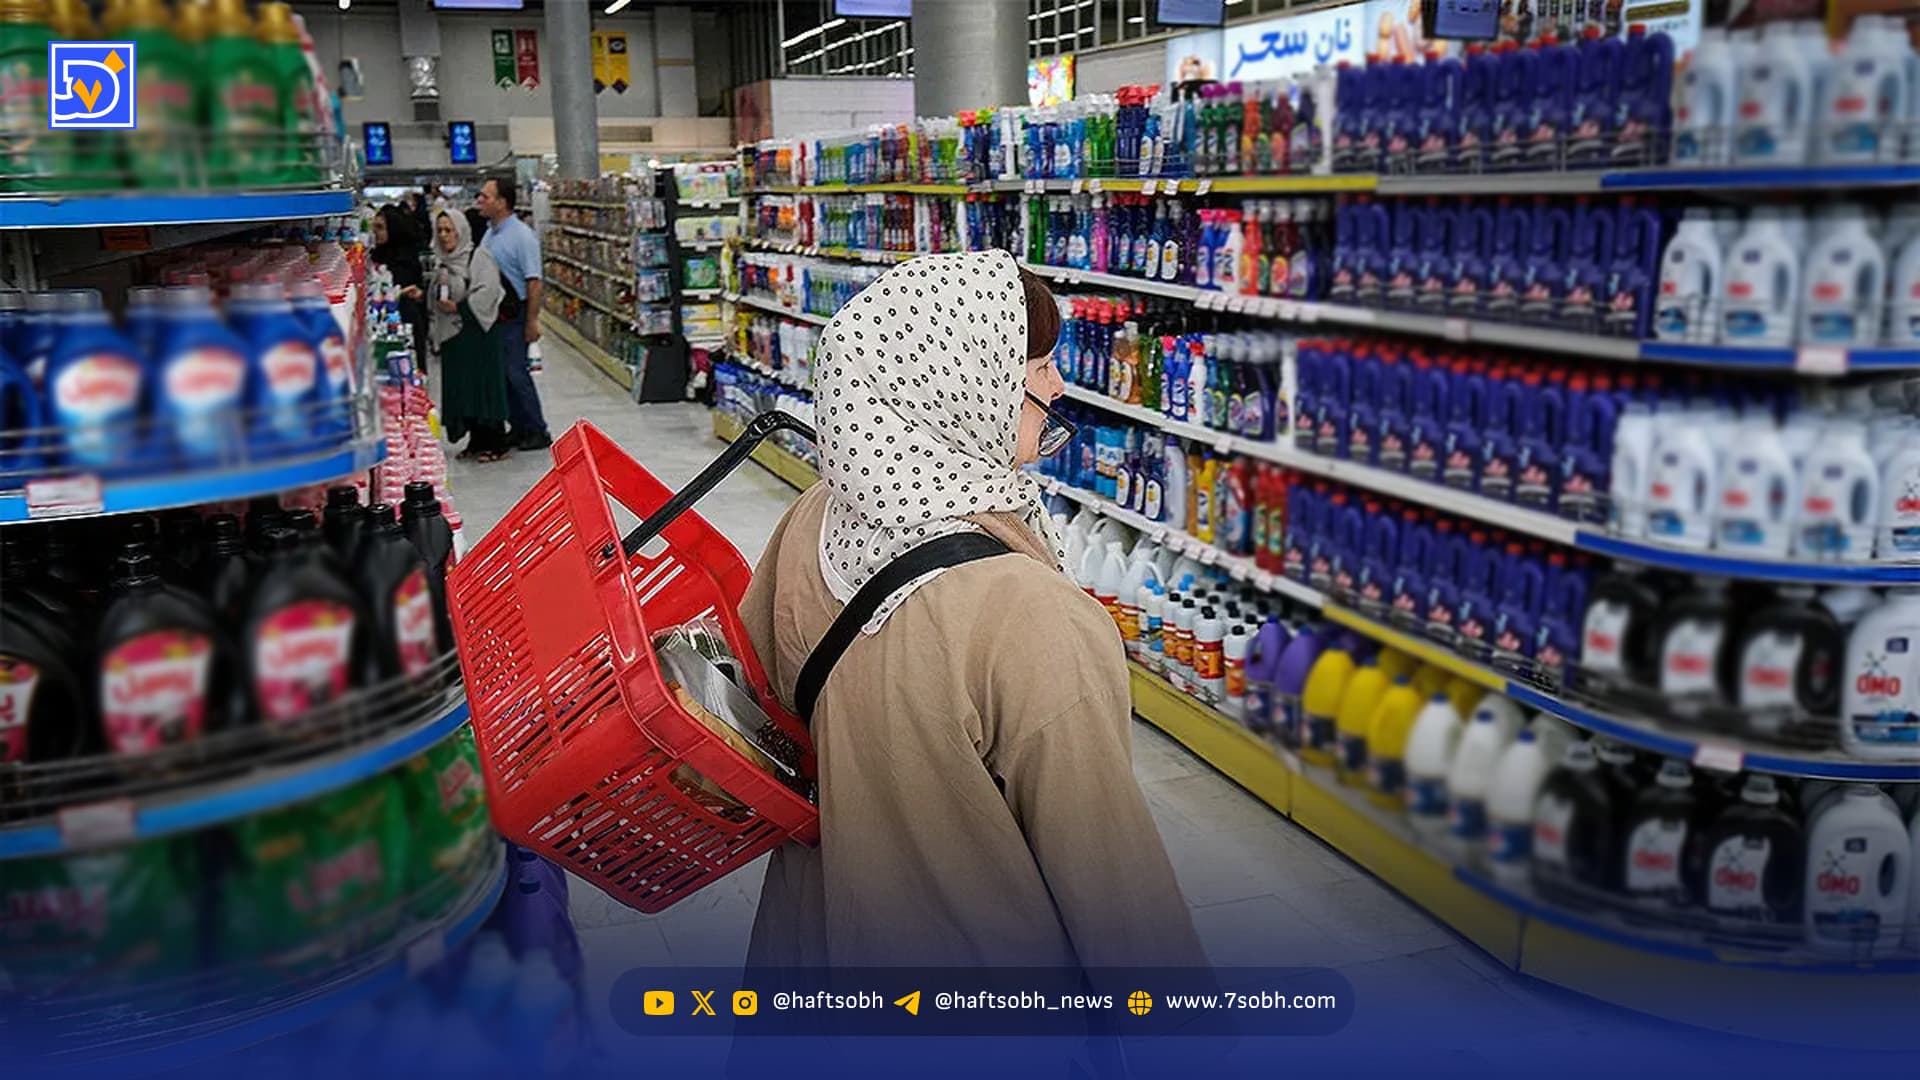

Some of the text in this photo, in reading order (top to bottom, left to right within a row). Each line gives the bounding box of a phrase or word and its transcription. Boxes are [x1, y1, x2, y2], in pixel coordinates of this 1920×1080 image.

[1315, 18, 1352, 64] نان
[1856, 673, 1902, 697] OMO
[1714, 866, 1758, 890] OMO
[1817, 871, 1860, 896] OMO
